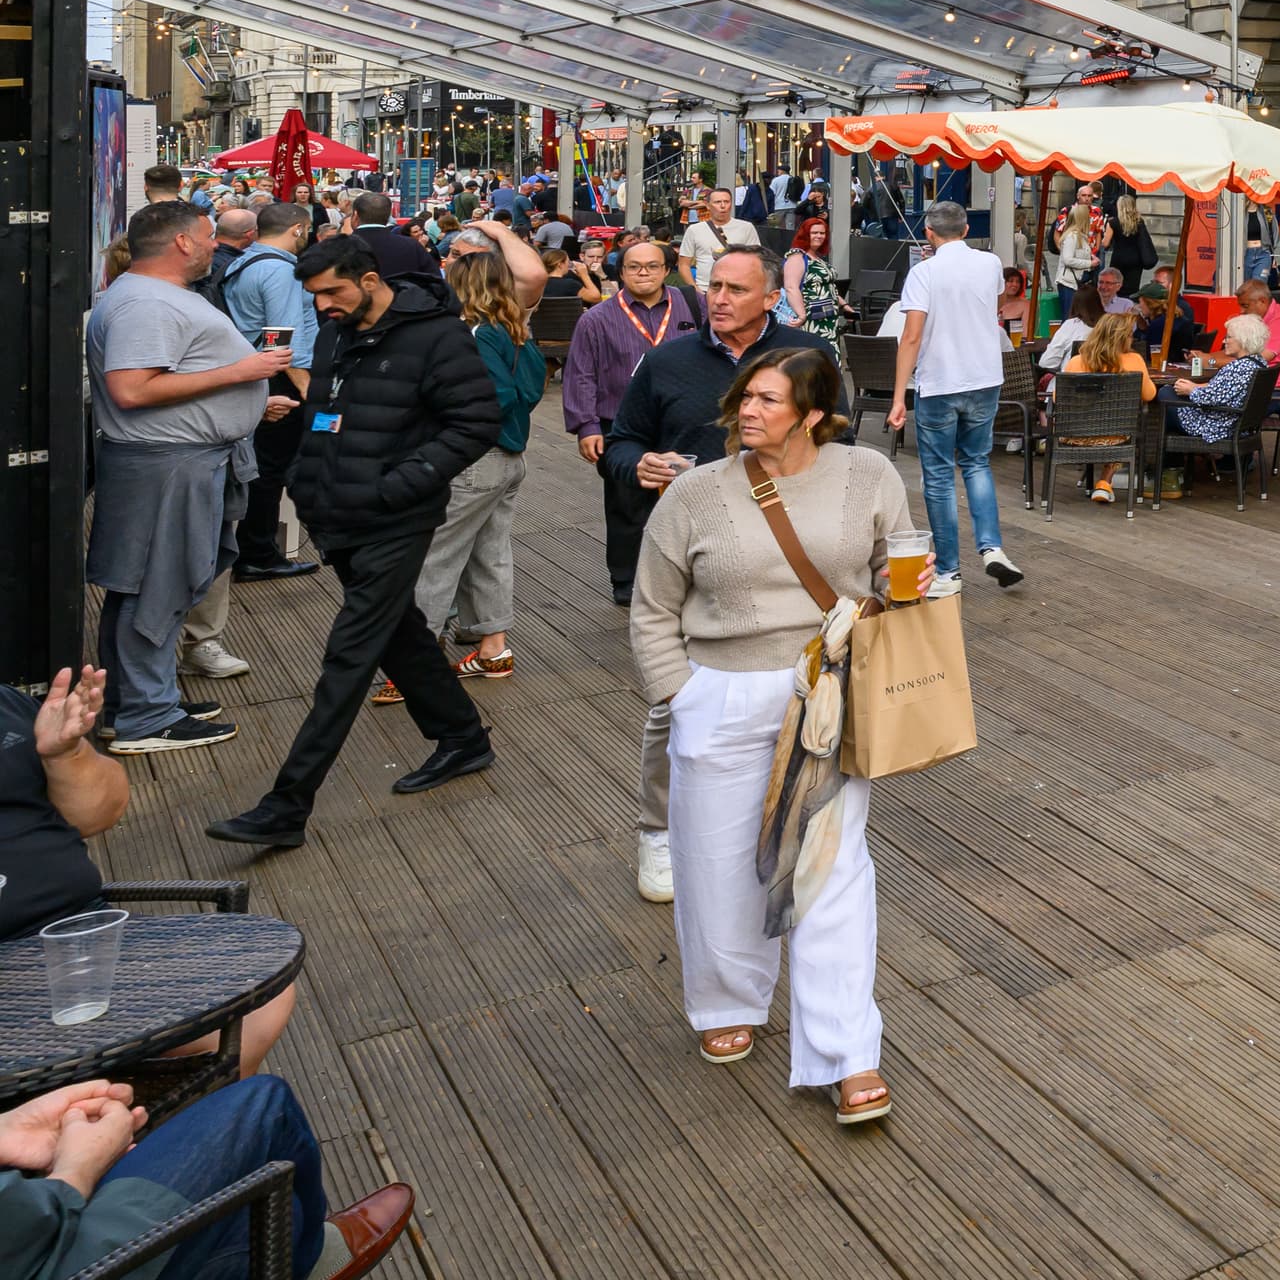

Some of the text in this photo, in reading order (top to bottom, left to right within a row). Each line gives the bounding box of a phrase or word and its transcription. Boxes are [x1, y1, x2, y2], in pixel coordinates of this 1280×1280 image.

[844, 120, 875, 136] APEROL
[964, 123, 999, 136] APEROL
[885, 672, 945, 696] MONSOON
